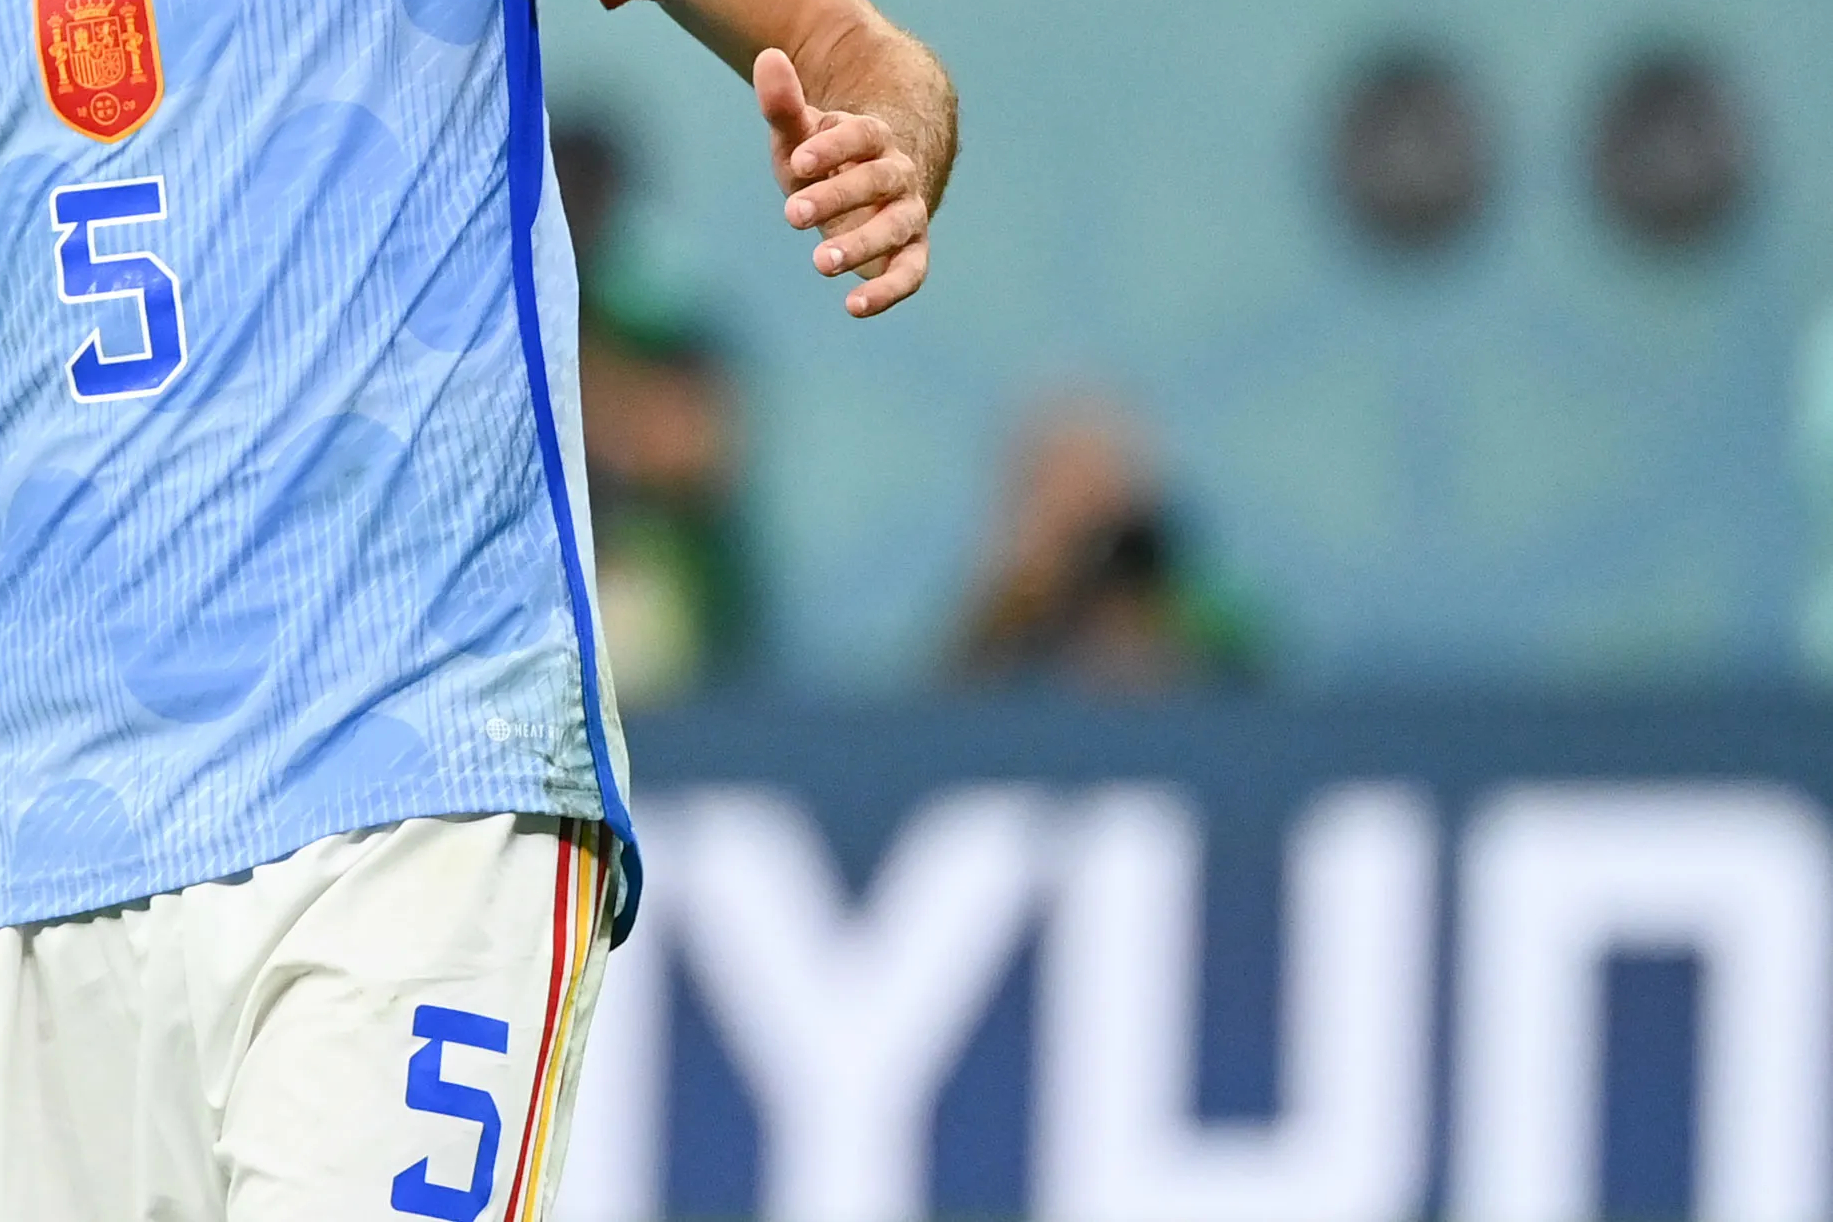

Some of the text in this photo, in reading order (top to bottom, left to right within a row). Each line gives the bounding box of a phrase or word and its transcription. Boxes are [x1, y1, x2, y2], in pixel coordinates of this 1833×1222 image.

[49, 175, 188, 404] 5
[390, 1004, 509, 1222] 5
[552, 783, 1831, 1222] YUN
